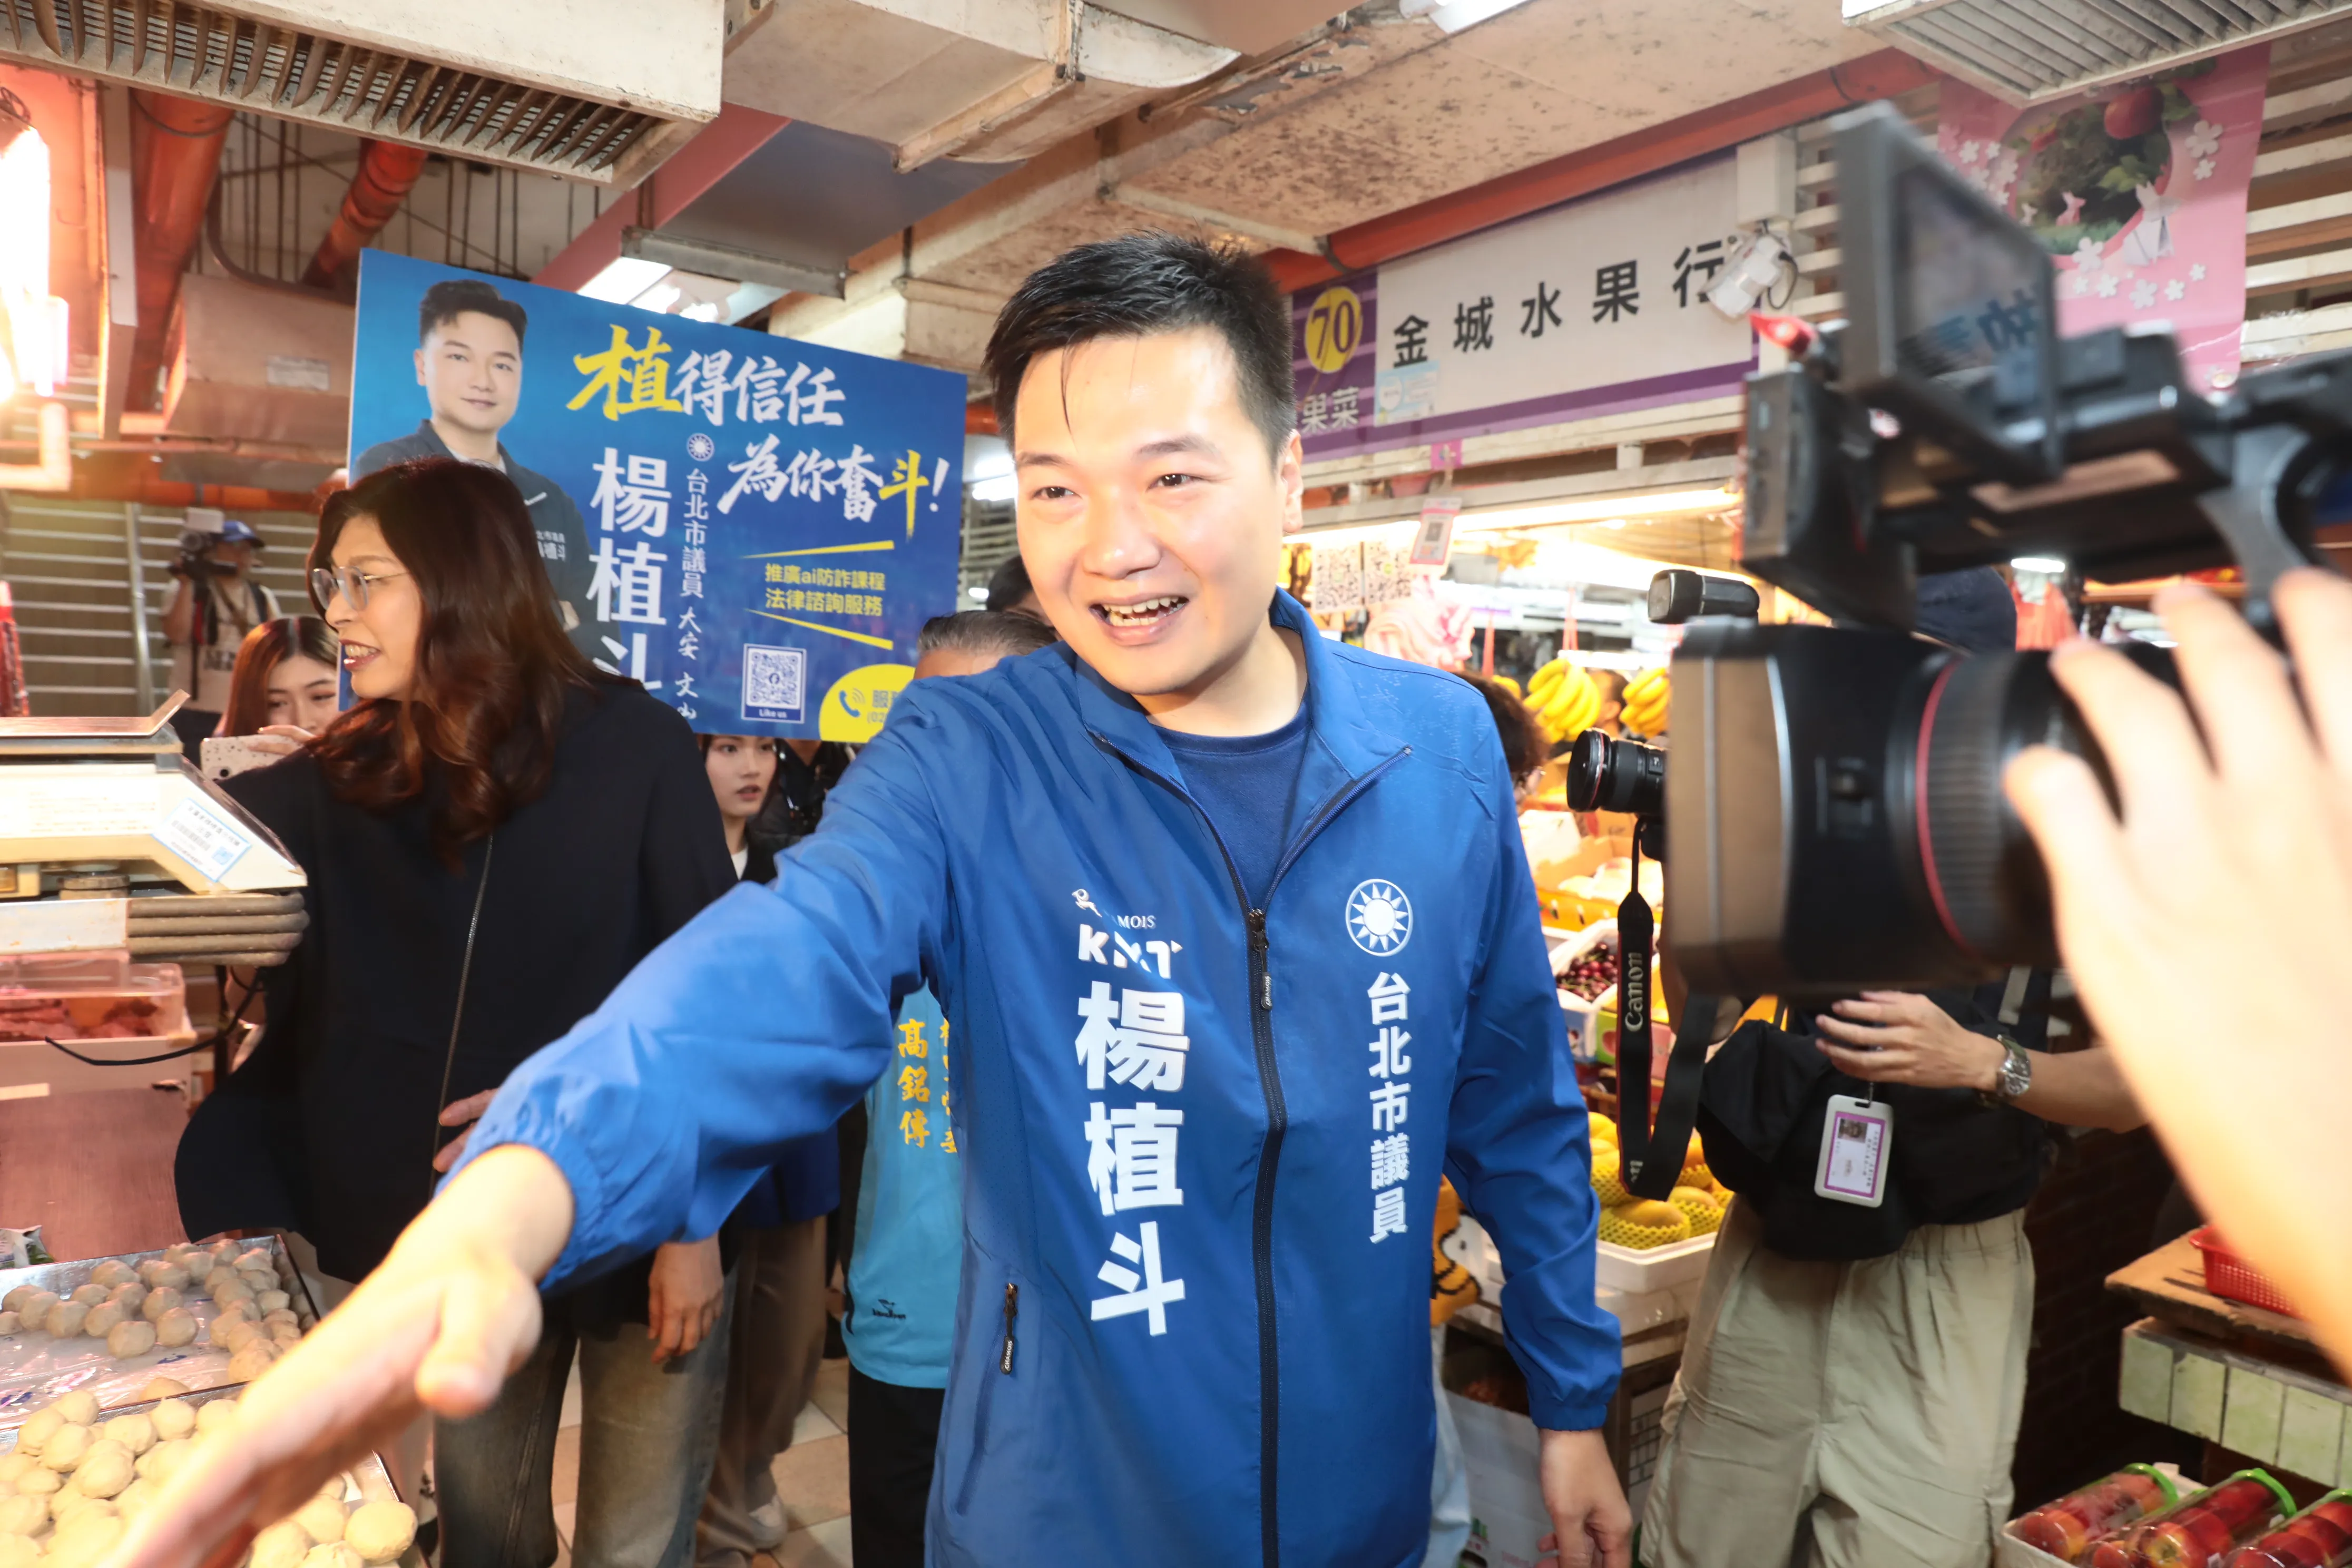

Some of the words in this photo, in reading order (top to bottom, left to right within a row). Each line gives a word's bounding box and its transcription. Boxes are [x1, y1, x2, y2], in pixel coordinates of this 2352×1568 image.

[1312, 300, 1355, 359] 70
[1393, 239, 1724, 368] 金城水果行
[566, 324, 846, 426] 植得信任
[1301, 386, 1359, 435] 果菜
[680, 468, 710, 599] 台北市議員
[766, 588, 883, 616] 法律諮詢服務
[1625, 952, 1643, 1032] Canon
[1075, 981, 1190, 1336] 楊植斗
[1367, 972, 1412, 1243] 台北市議員
